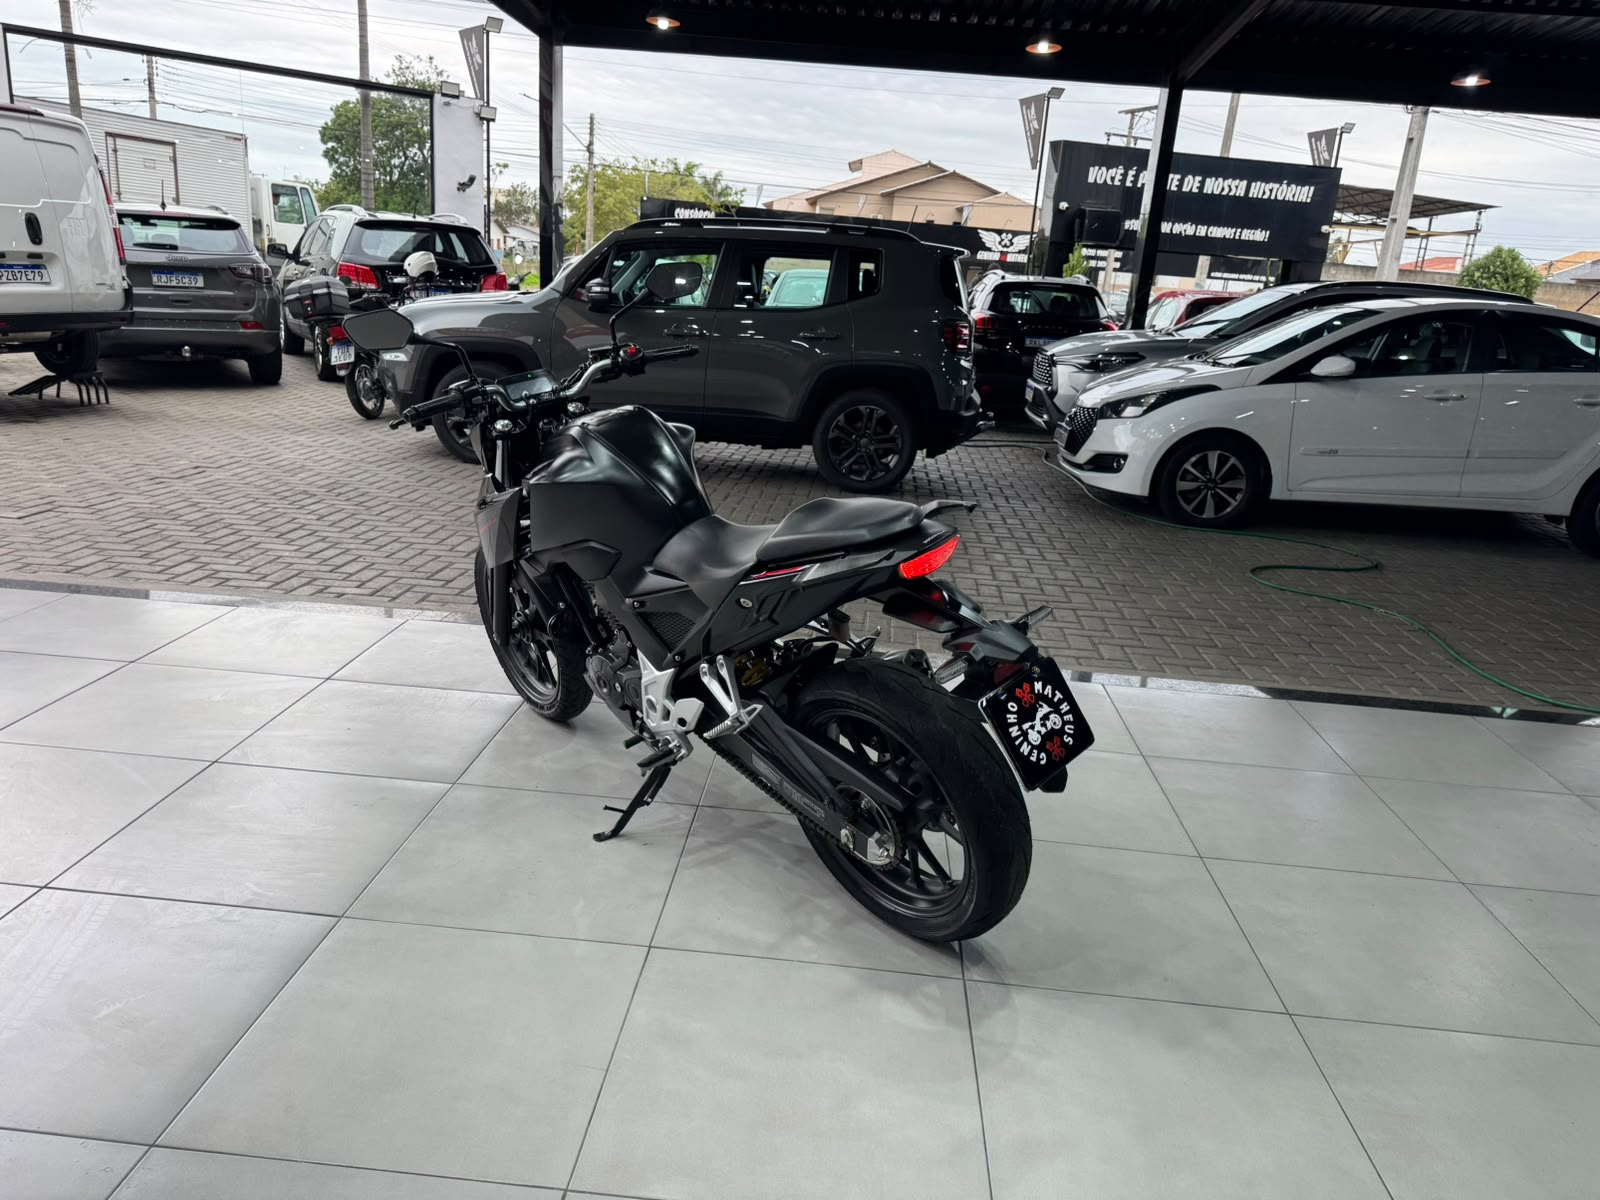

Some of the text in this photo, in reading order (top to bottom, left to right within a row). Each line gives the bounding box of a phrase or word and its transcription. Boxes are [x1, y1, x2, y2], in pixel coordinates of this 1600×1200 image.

[1087, 165, 1125, 186] VOCÊ
[1125, 166, 1137, 187] É
[1182, 174, 1202, 193] DE
[1203, 176, 1248, 197] NOSSA
[1248, 180, 1315, 203] HISTÓRIA!
[1172, 221, 1196, 237] OPÇÃO
[1195, 224, 1208, 237] EM
[1207, 225, 1236, 239] CAMPOS
[1235, 228, 1241, 239] E
[156, 275, 199, 286] RJF5C39
[1033, 680, 1075, 746] MATHEUS
[1006, 701, 1047, 765] GENINHO
